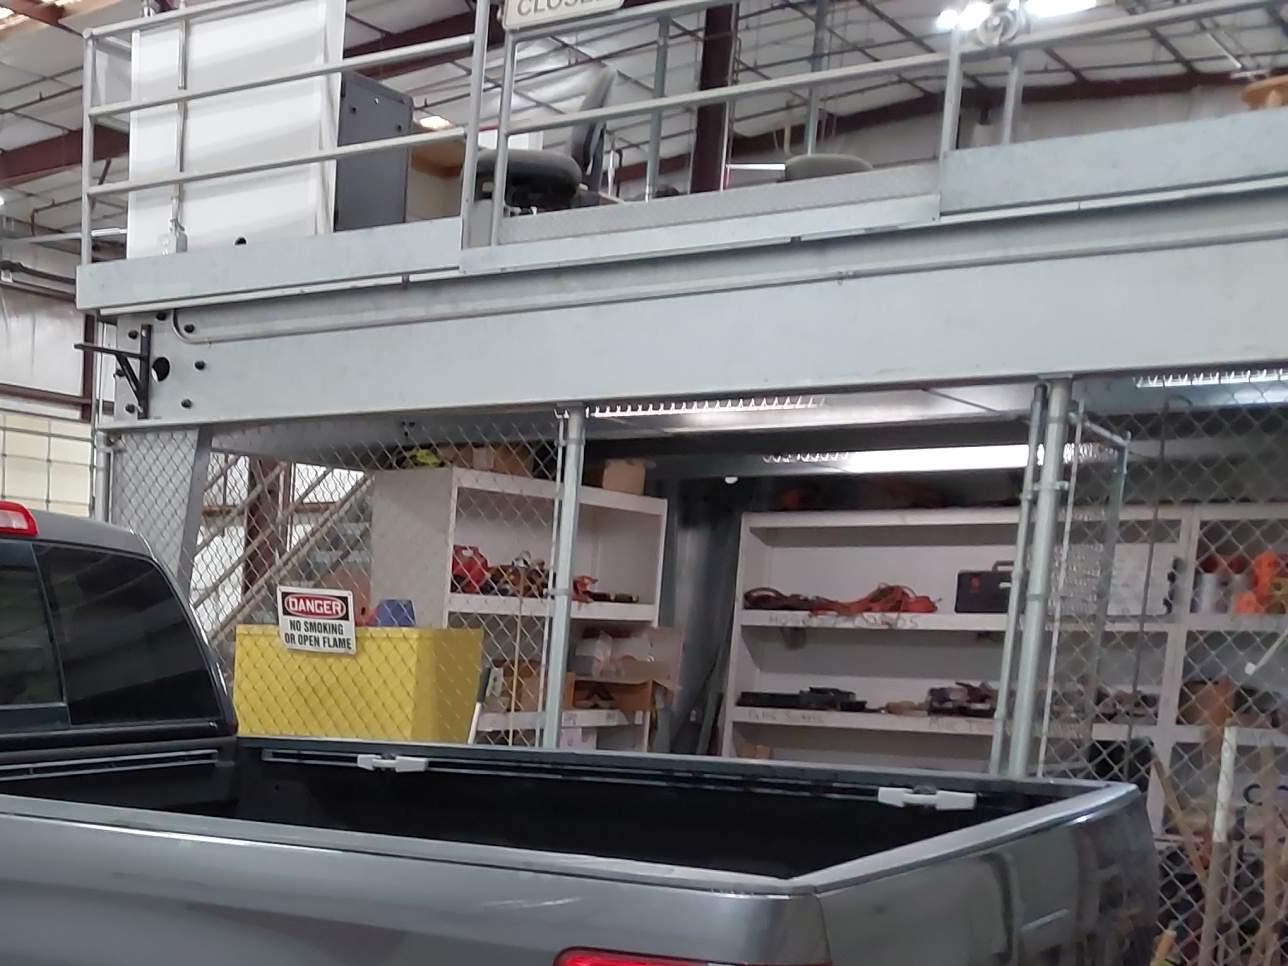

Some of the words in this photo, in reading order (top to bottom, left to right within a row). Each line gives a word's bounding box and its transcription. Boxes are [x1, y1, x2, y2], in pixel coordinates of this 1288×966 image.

[289, 597, 342, 615] DANGER
[289, 620, 302, 631] NO
[304, 621, 344, 635] SMOKING
[285, 633, 296, 644] OR
[298, 634, 321, 648] OPEN
[323, 637, 352, 650] FLAME
